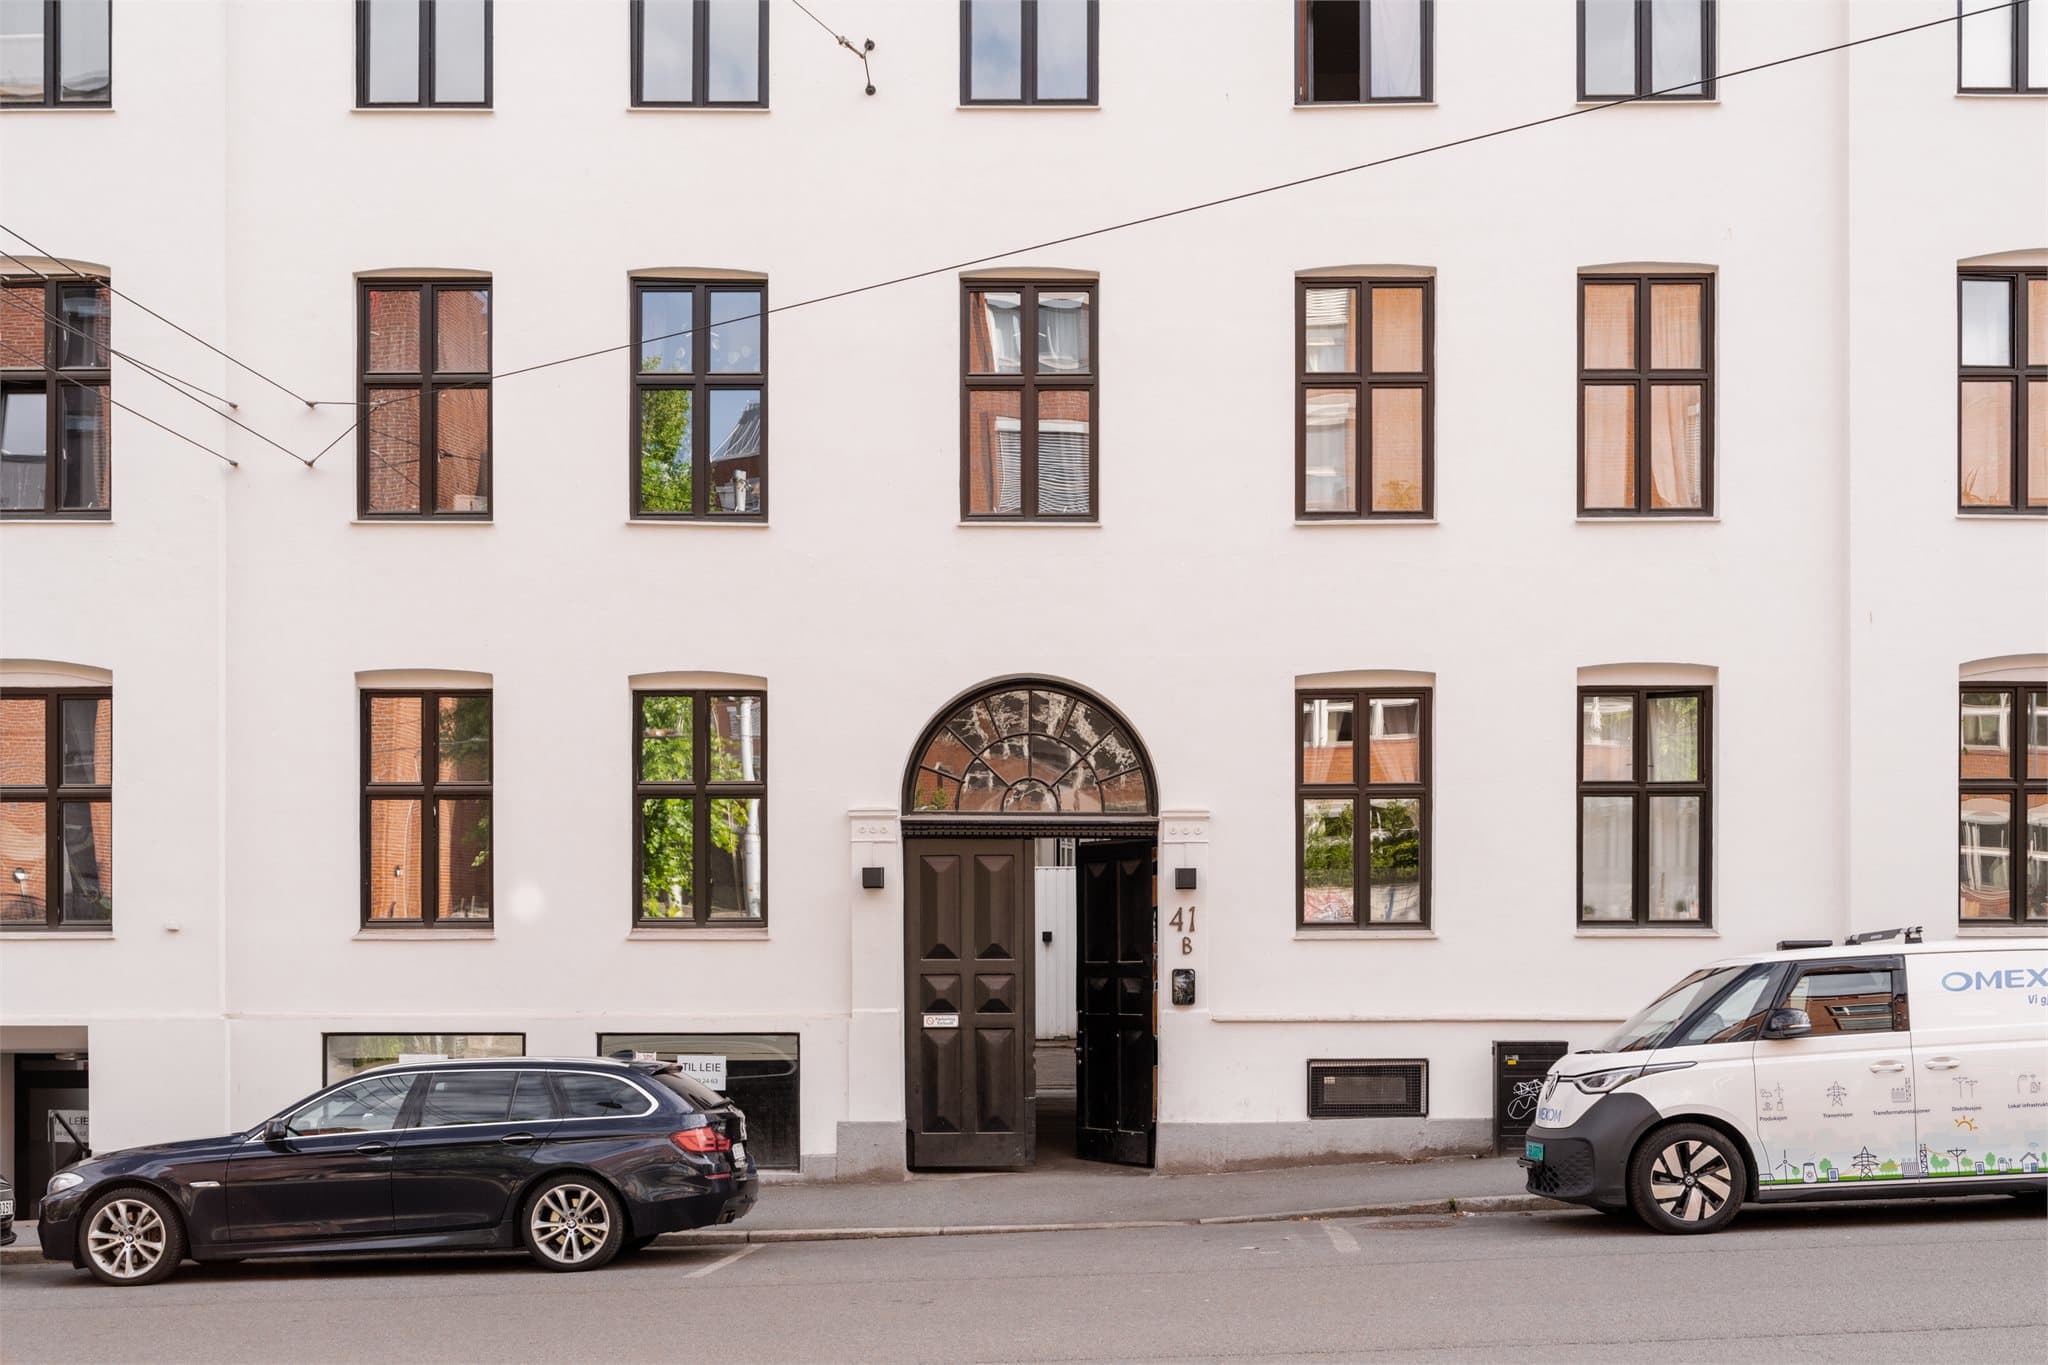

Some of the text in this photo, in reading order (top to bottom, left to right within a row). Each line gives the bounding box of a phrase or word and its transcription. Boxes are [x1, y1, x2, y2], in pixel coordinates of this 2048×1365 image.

[1169, 906, 1196, 932] 41
[1182, 936, 1193, 955] B
[1941, 968, 2048, 992] OMEX
[2028, 994, 2038, 1004] Vi
[683, 1062, 721, 1072] TIL LEIE
[69, 1116, 88, 1126] LEIE
